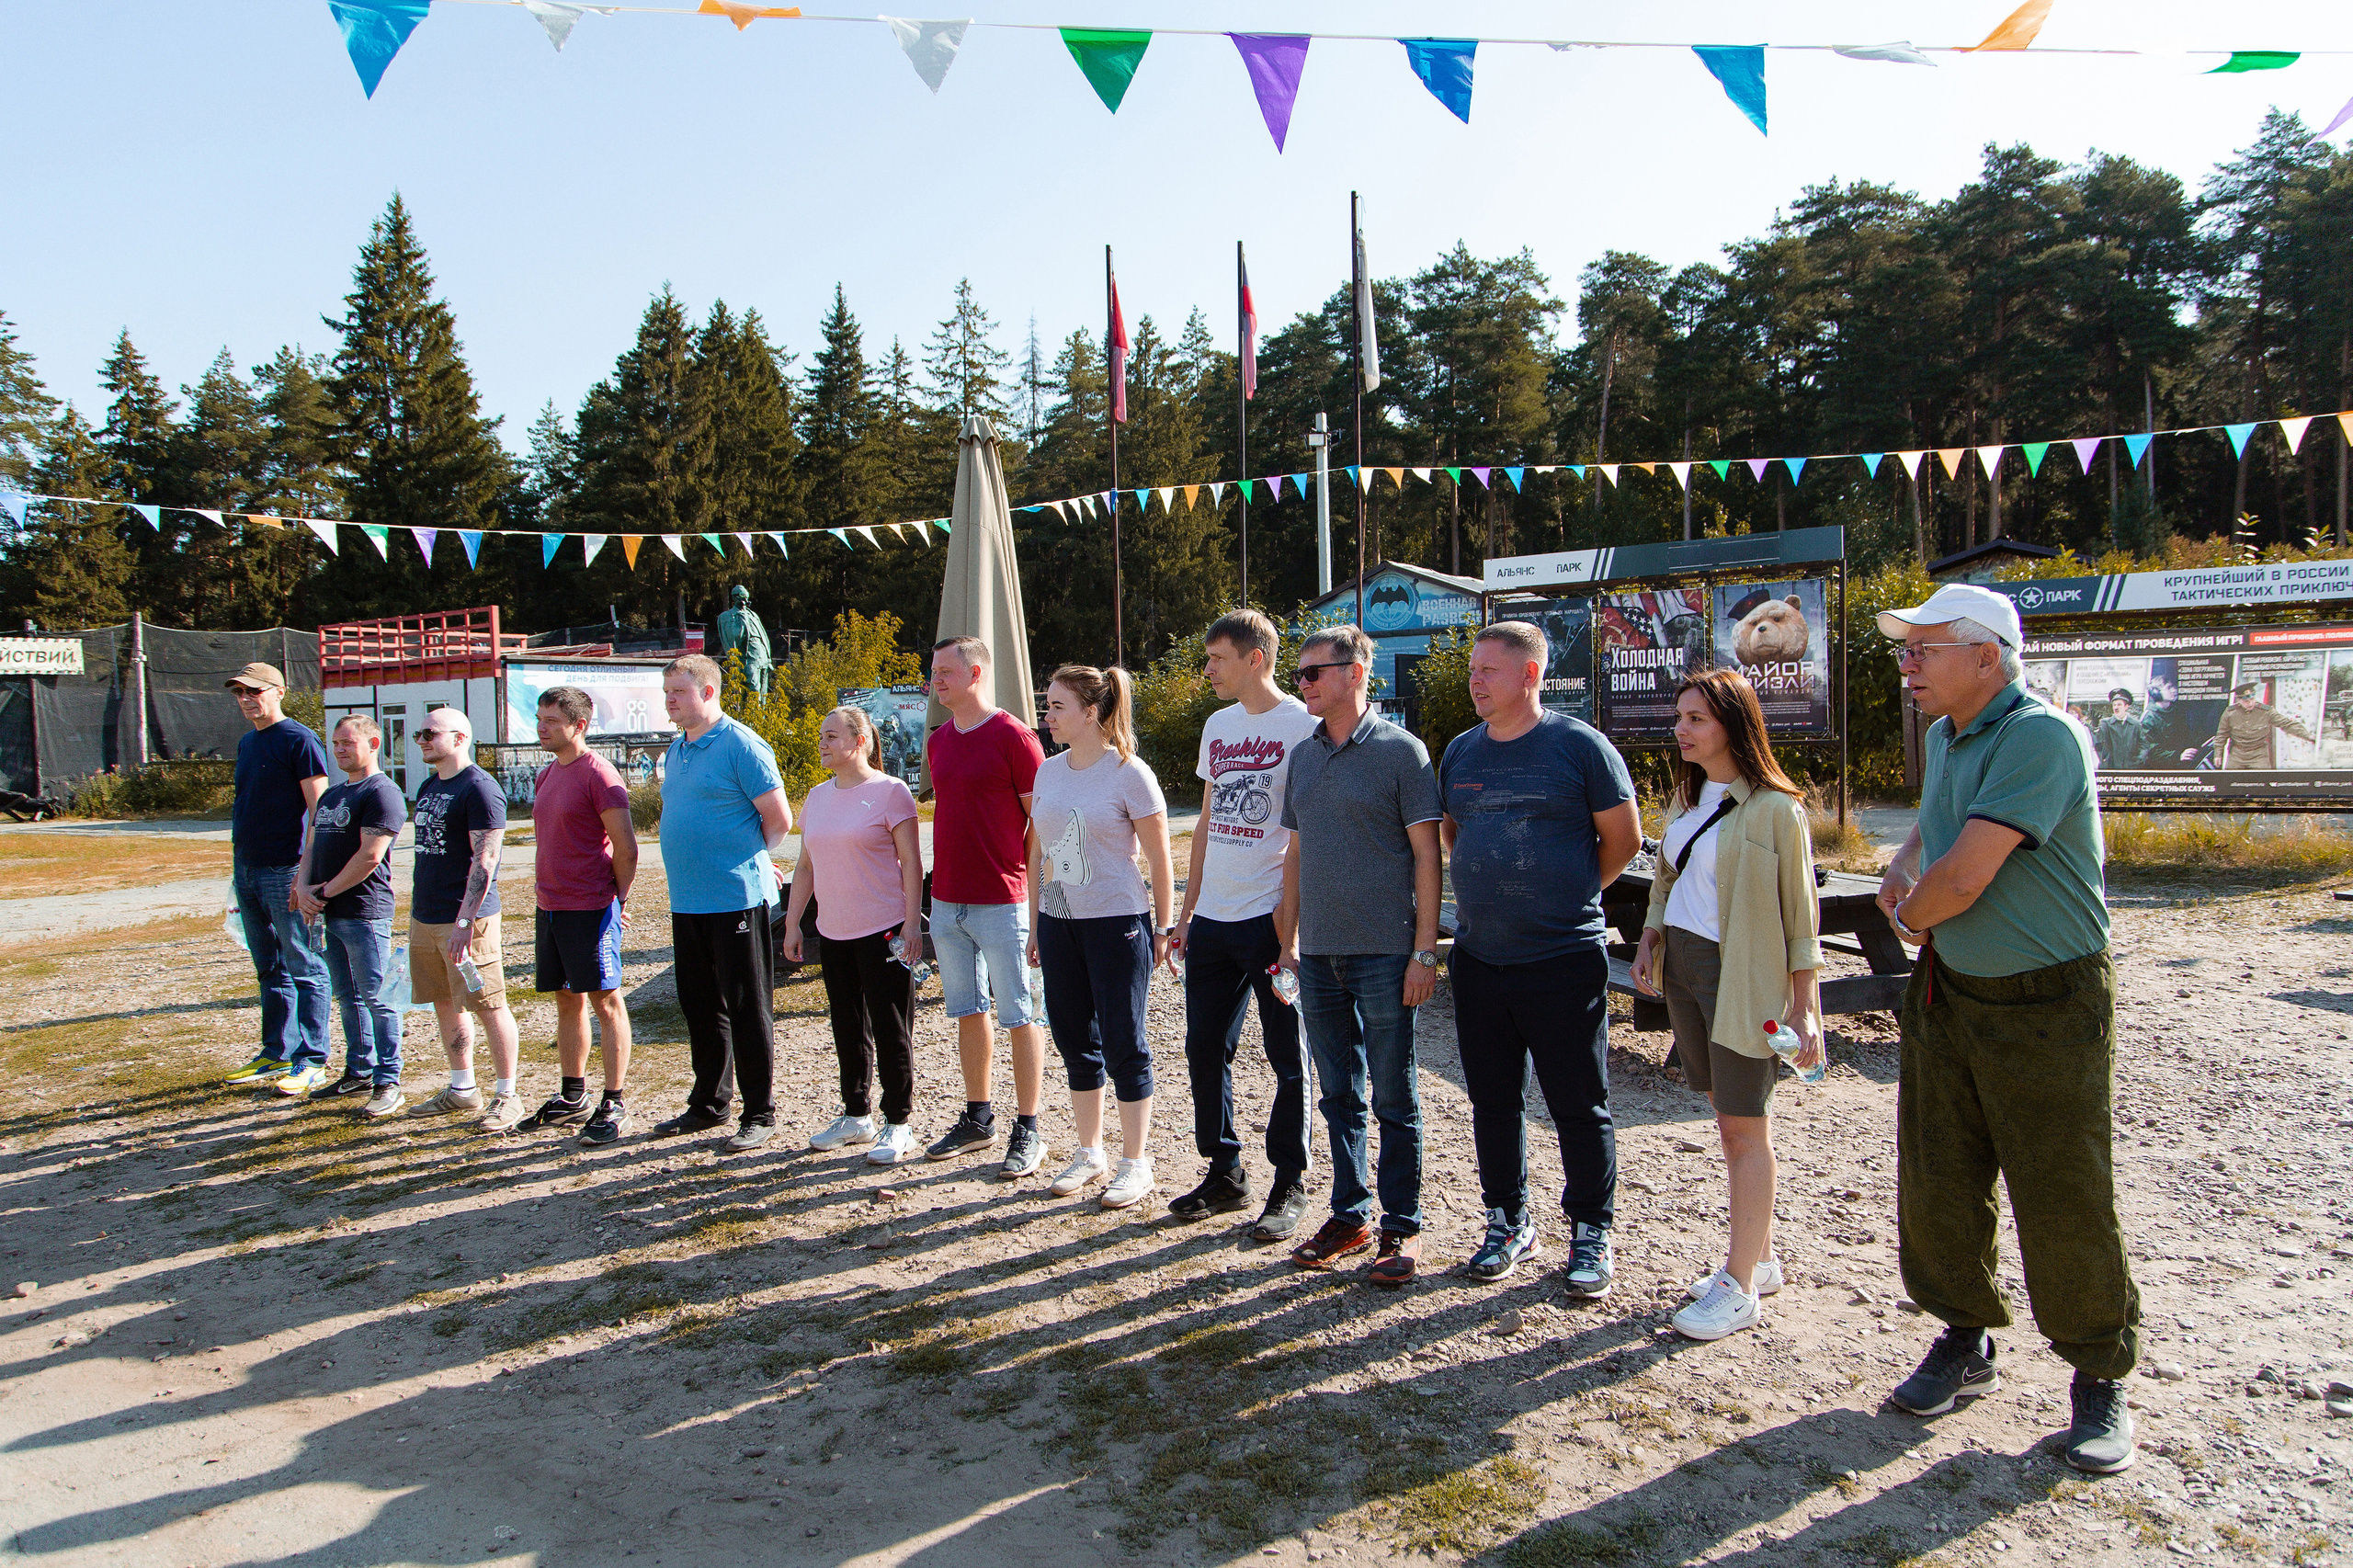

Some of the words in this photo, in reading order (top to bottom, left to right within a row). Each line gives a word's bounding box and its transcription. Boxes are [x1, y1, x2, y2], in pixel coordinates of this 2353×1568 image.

[1496, 566, 1535, 577] АЛЬЯНС
[1557, 562, 1582, 574] ПАРК
[2164, 568, 2265, 587] КРУПНЕЙШИЙ
[2271, 570, 2279, 581] В
[2287, 566, 2349, 580] РОССИИ
[2045, 589, 2082, 603] ПАРК
[2171, 585, 2273, 601] ТАКТИЧЕСКИХ
[1423, 597, 1476, 610] ВОЕННАЯ
[2041, 638, 2083, 653] НОВЫЙ
[2084, 639, 2132, 652] ФОРМАТ
[2134, 636, 2214, 651] ПРОВЕДЕНИЯ
[2215, 634, 2244, 645] ИГР!
[2254, 632, 2288, 642] ГЛАВНЫЙ
[1611, 647, 1684, 669] ХОЛОДНАЯ
[1728, 661, 1814, 677] МАЙОР
[566, 675, 588, 683] ДЕНЬ
[590, 675, 607, 683] ДЛЯ
[1611, 669, 1656, 691] ВОЙНА
[892, 685, 920, 693] АЛЬЯНС
[1209, 736, 1285, 767] Brooklyn
[1261, 776, 1270, 787] 19
[2114, 776, 2202, 784] СПЕЦПОДРАЗДЕЛЕНИЯ,
[1231, 825, 1264, 839] SPEED
[602, 935, 614, 979] HOLLISTER
